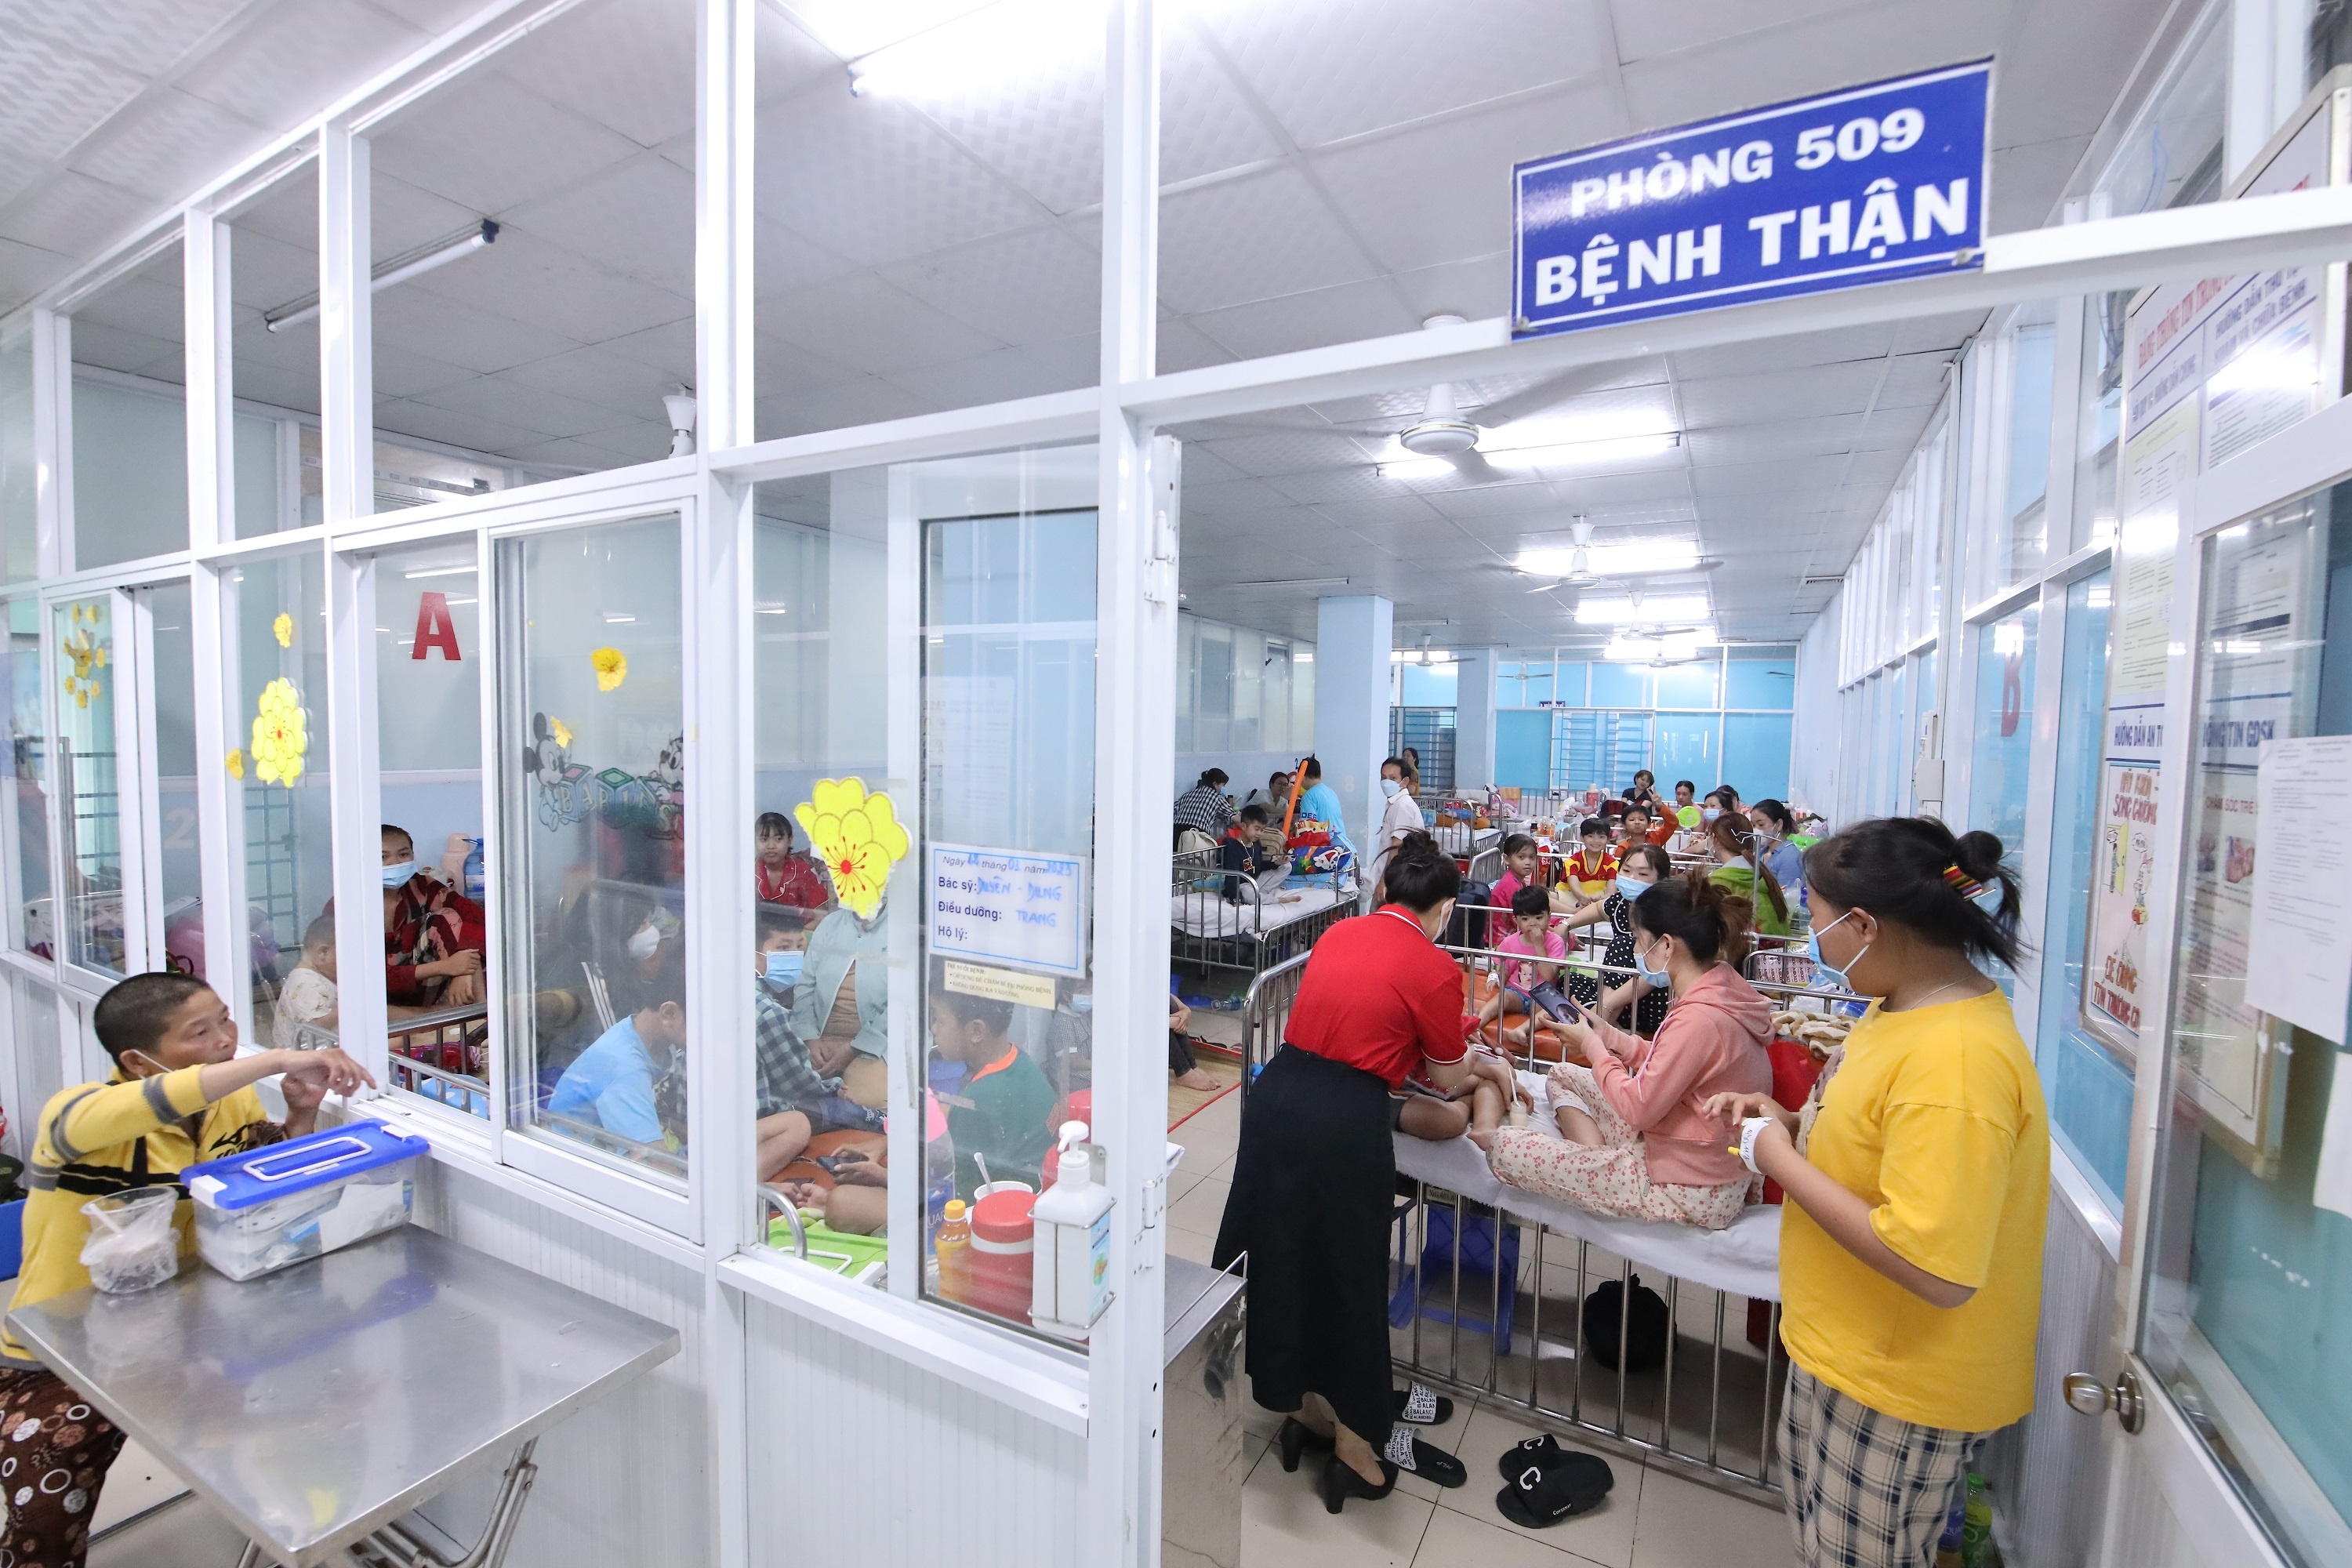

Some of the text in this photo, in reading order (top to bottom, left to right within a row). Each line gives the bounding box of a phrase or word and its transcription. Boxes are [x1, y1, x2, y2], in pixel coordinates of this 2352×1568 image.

[1569, 107, 1925, 219] PHÒNG 509
[1535, 176, 1969, 305] BỆNH THẬN
[412, 592, 462, 660] A
[2114, 720, 2132, 746] HƯỚNG
[2133, 715, 2146, 747] DẪN
[2147, 725, 2156, 747] AN
[2227, 721, 2244, 747] TIN
[163, 808, 196, 849] 2
[942, 856, 966, 867] Ngày
[982, 860, 1007, 872] tháng
[1025, 866, 1045, 874] năm
[938, 877, 958, 888] Bác
[961, 880, 977, 893] sỹ:
[964, 905, 1002, 922] dưỡng:
[1016, 909, 1057, 928] TRANG
[938, 925, 967, 941] Hộ lý:
[1524, 1436, 1544, 1450] C
[1519, 1466, 1541, 1490] C
